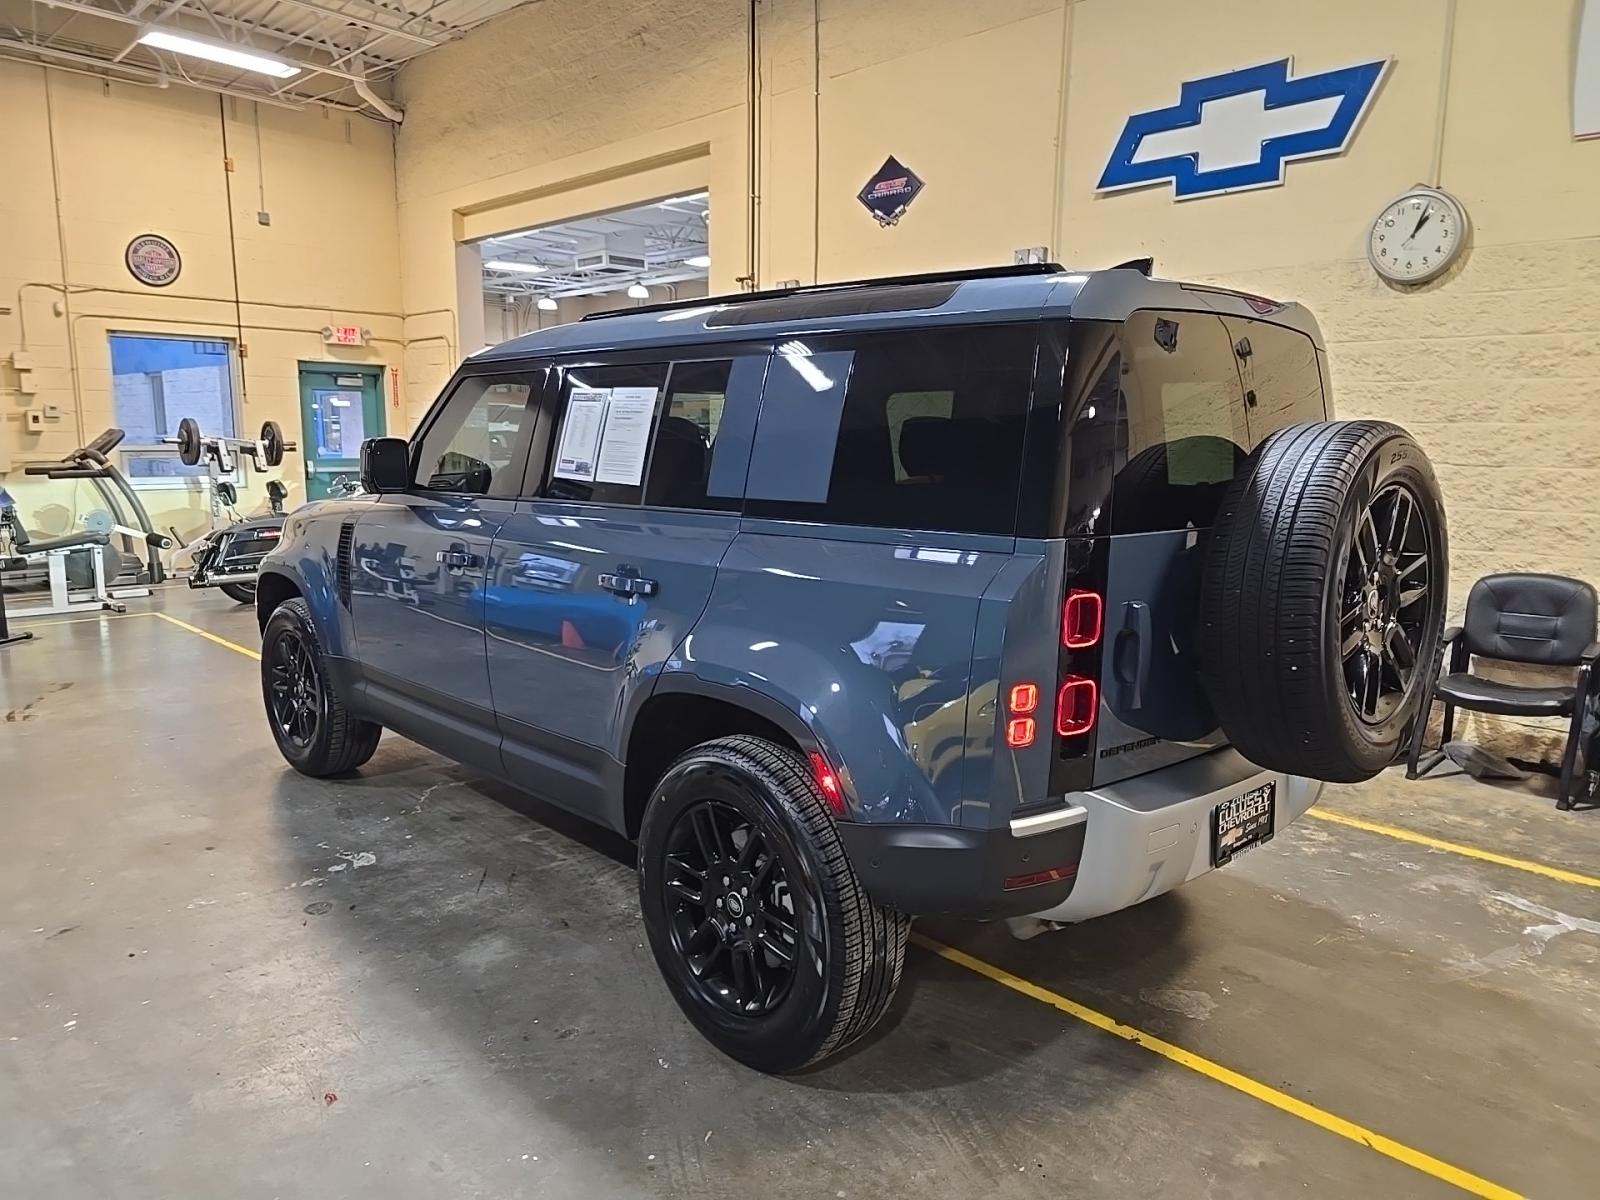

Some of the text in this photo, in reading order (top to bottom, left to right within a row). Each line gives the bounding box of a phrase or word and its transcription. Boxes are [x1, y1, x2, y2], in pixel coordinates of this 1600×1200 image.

[1412, 202, 1421, 211] 12
[1397, 208, 1405, 216] 11
[1440, 214, 1446, 223] 2
[1385, 219, 1395, 228] 10
[1379, 234, 1385, 242] 9
[1442, 229, 1448, 238] 3
[1381, 247, 1387, 257] 8
[1435, 245, 1441, 253] 4
[1392, 257, 1398, 266] 7
[1406, 260, 1412, 269] 6
[1422, 256, 1429, 265] 5
[1390, 451, 1408, 465] 255
[1218, 801, 1270, 835] CHEVROLET
